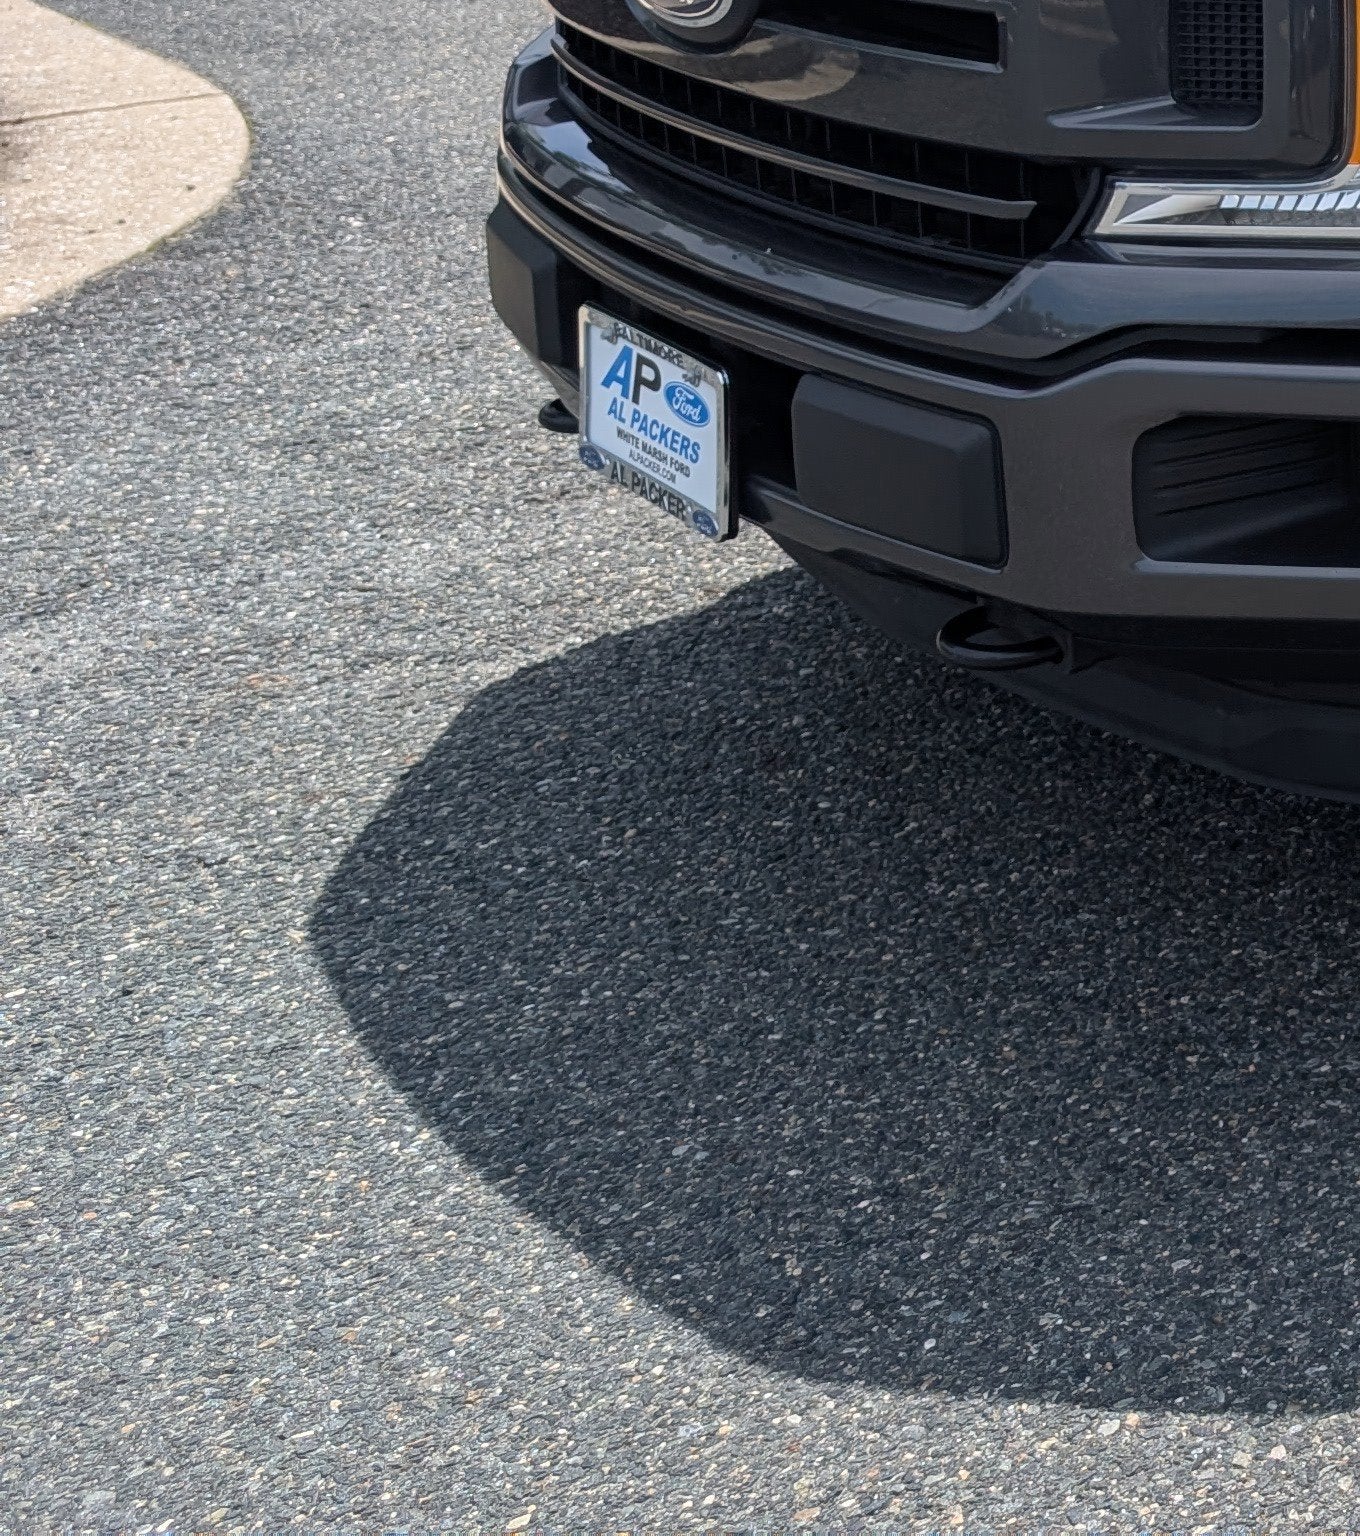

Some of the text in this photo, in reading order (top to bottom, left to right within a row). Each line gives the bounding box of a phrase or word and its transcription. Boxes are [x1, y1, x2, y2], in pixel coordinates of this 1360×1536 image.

[601, 345, 662, 405] AP
[672, 386, 702, 421] Ford
[608, 396, 626, 424] AL
[630, 408, 701, 464] PACKERS
[616, 425, 691, 478] WHITE MARSH FORD
[610, 462, 686, 521] AL PACKER
